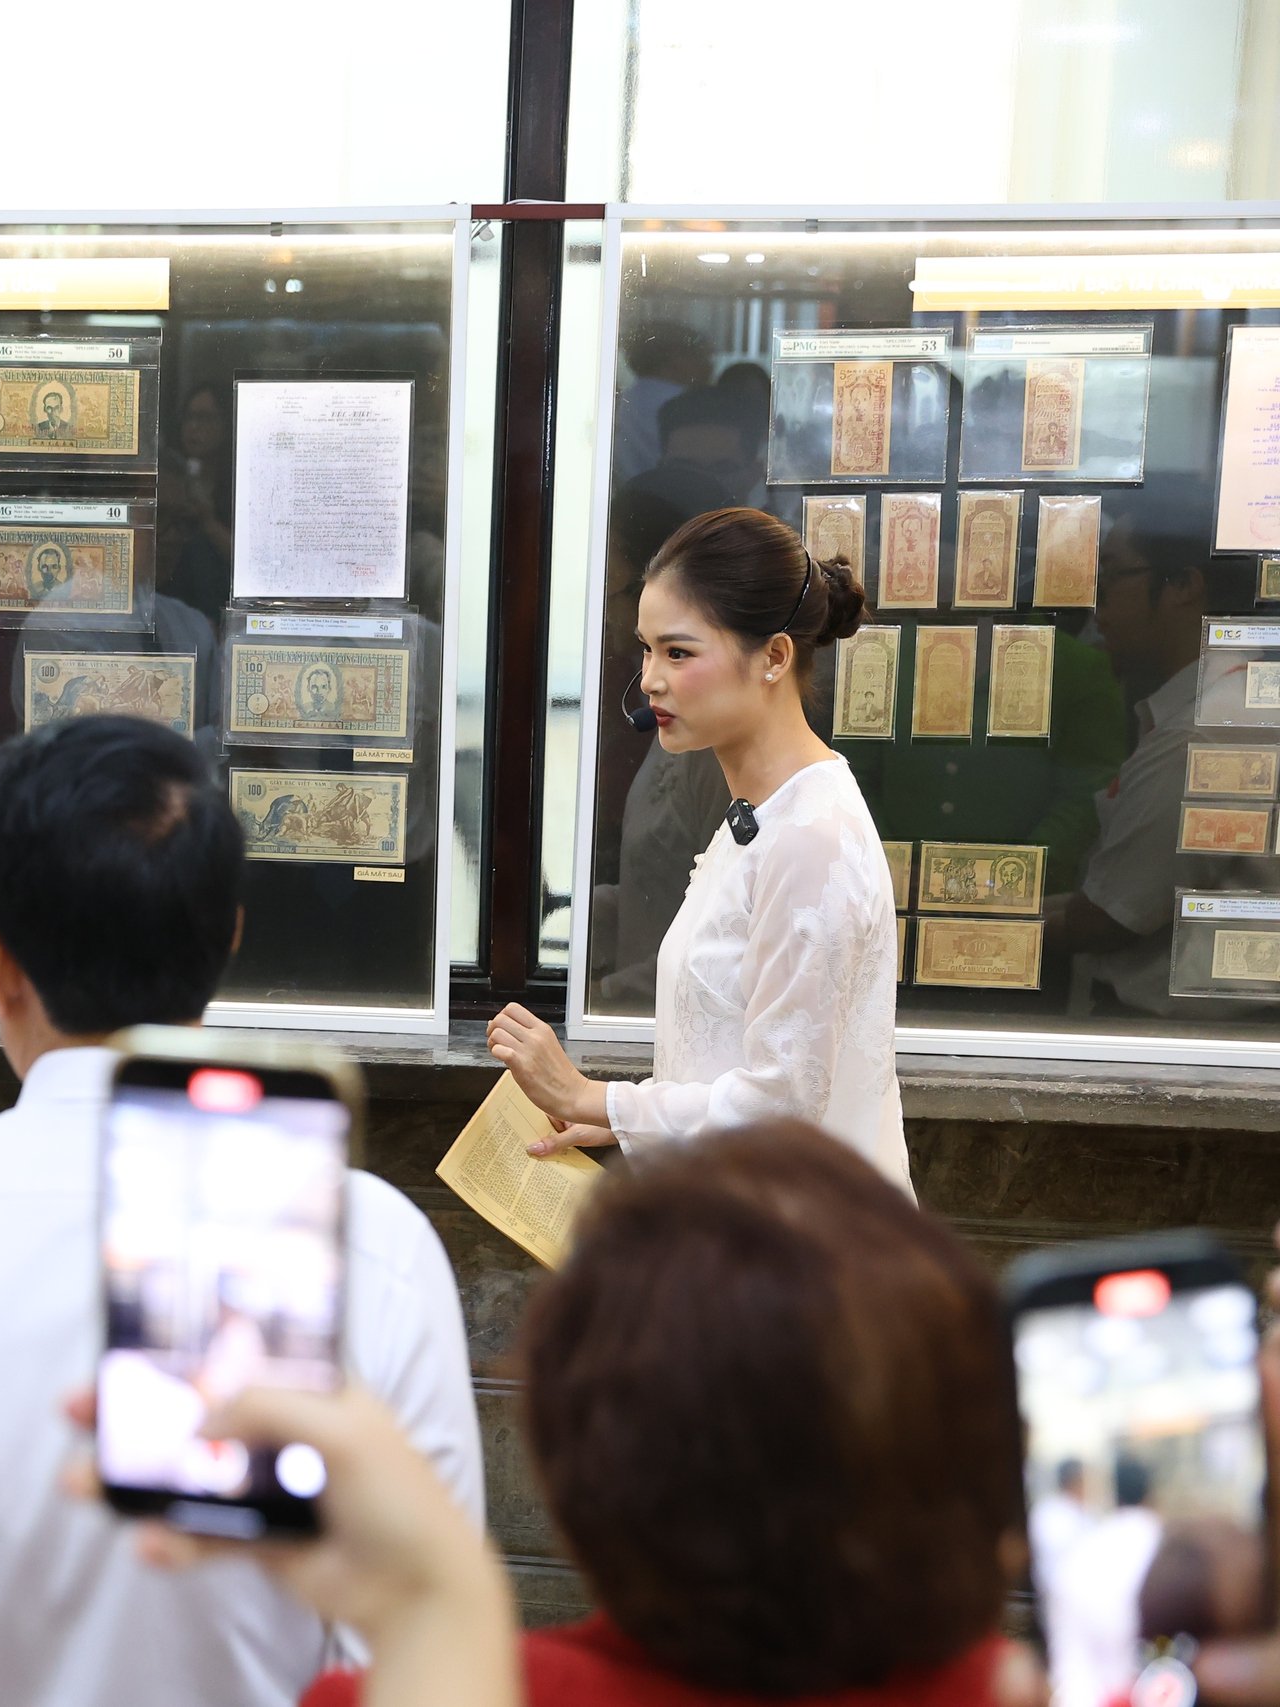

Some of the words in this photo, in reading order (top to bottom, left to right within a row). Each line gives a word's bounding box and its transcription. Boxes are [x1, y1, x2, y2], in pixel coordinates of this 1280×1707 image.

[793, 341, 817, 351] PMG
[921, 341, 937, 352] 53
[108, 347, 123, 359] 50
[106, 507, 121, 518] 40
[244, 662, 263, 673] 100
[247, 784, 262, 796] 100
[381, 840, 395, 852] 100
